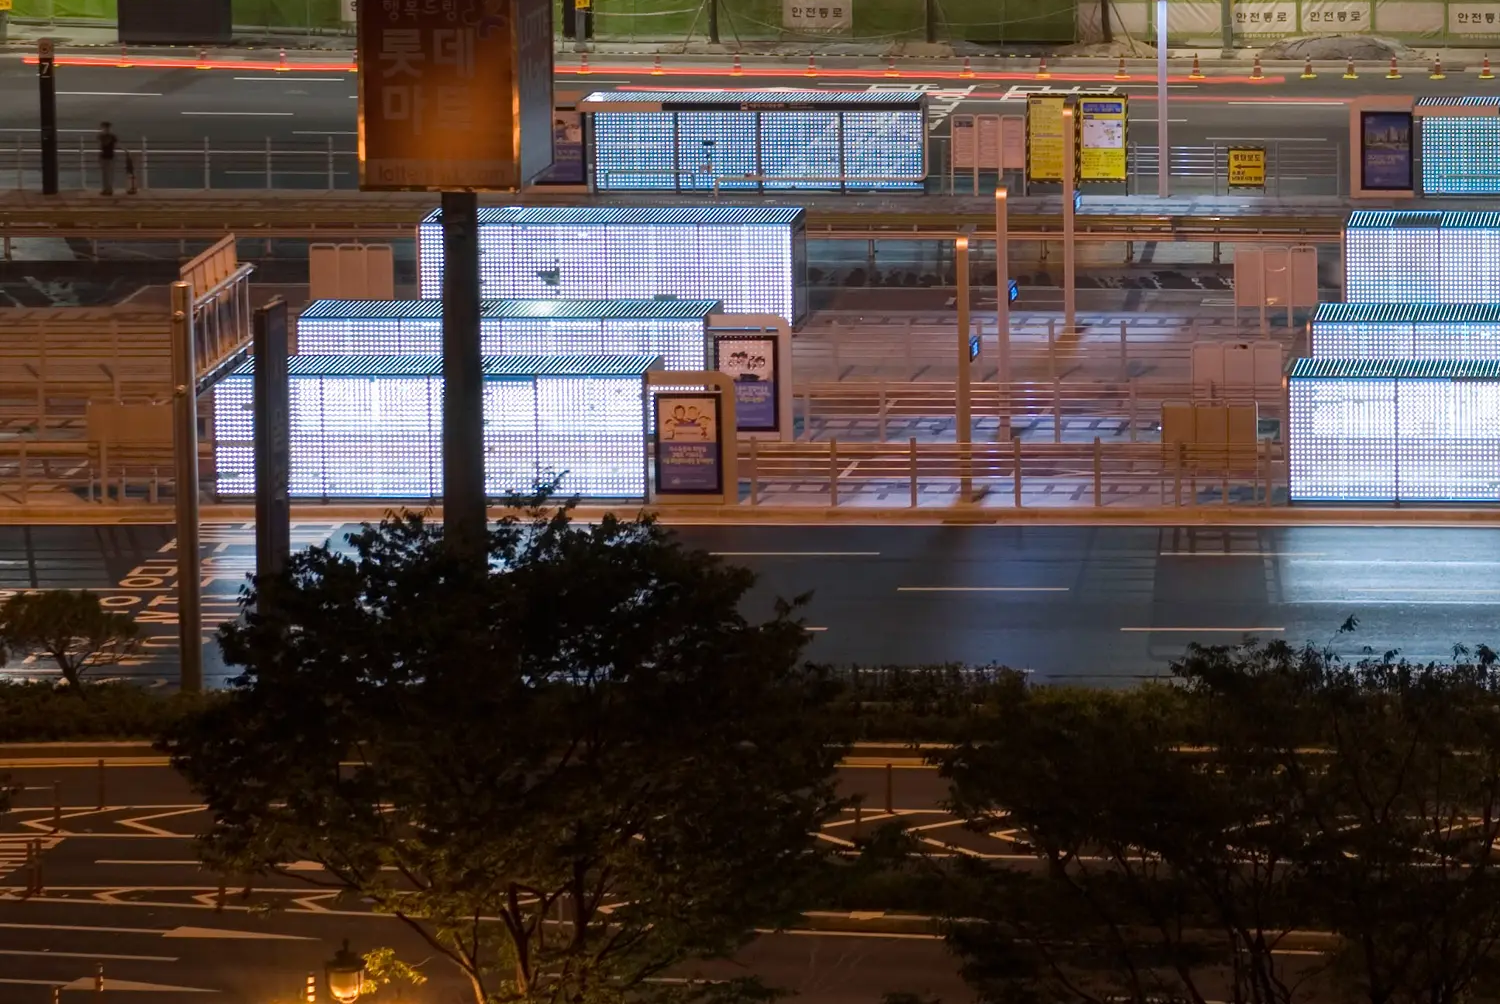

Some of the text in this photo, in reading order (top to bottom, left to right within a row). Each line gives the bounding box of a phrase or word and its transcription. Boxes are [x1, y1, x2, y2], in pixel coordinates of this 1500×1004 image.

[791, 6, 843, 19] 안전통로
[1236, 11, 1287, 23] 안전통로
[1309, 10, 1361, 23] 안전통로
[378, 28, 475, 79] 롯데
[41, 62, 50, 75] 7
[381, 84, 474, 136] 마트
